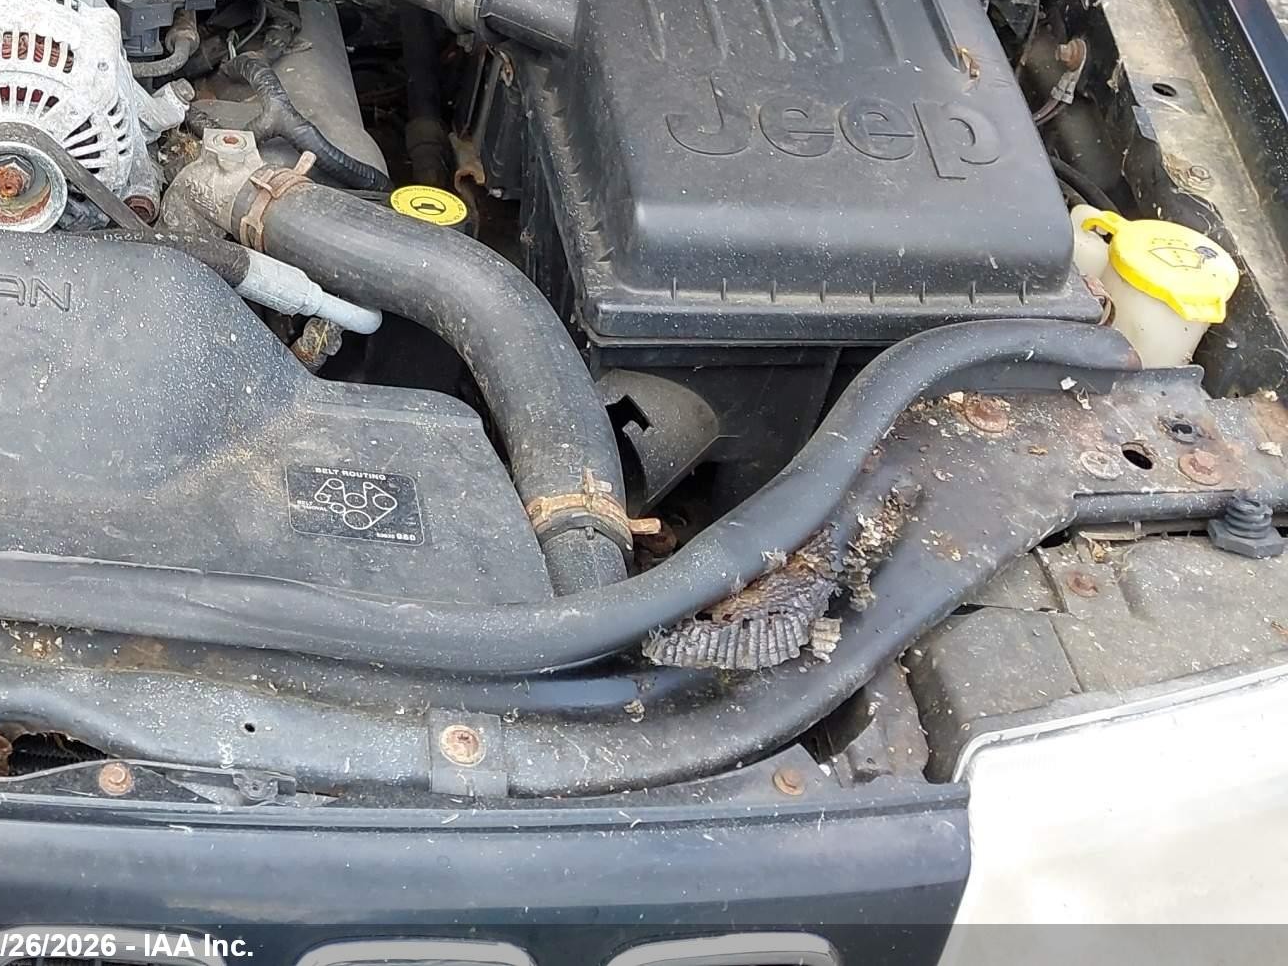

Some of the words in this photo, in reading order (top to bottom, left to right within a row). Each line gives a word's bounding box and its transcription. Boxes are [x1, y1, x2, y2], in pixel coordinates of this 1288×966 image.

[664, 77, 1001, 181] Jeep
[314, 467, 339, 475] BELT
[341, 469, 387, 481] ROUTING
